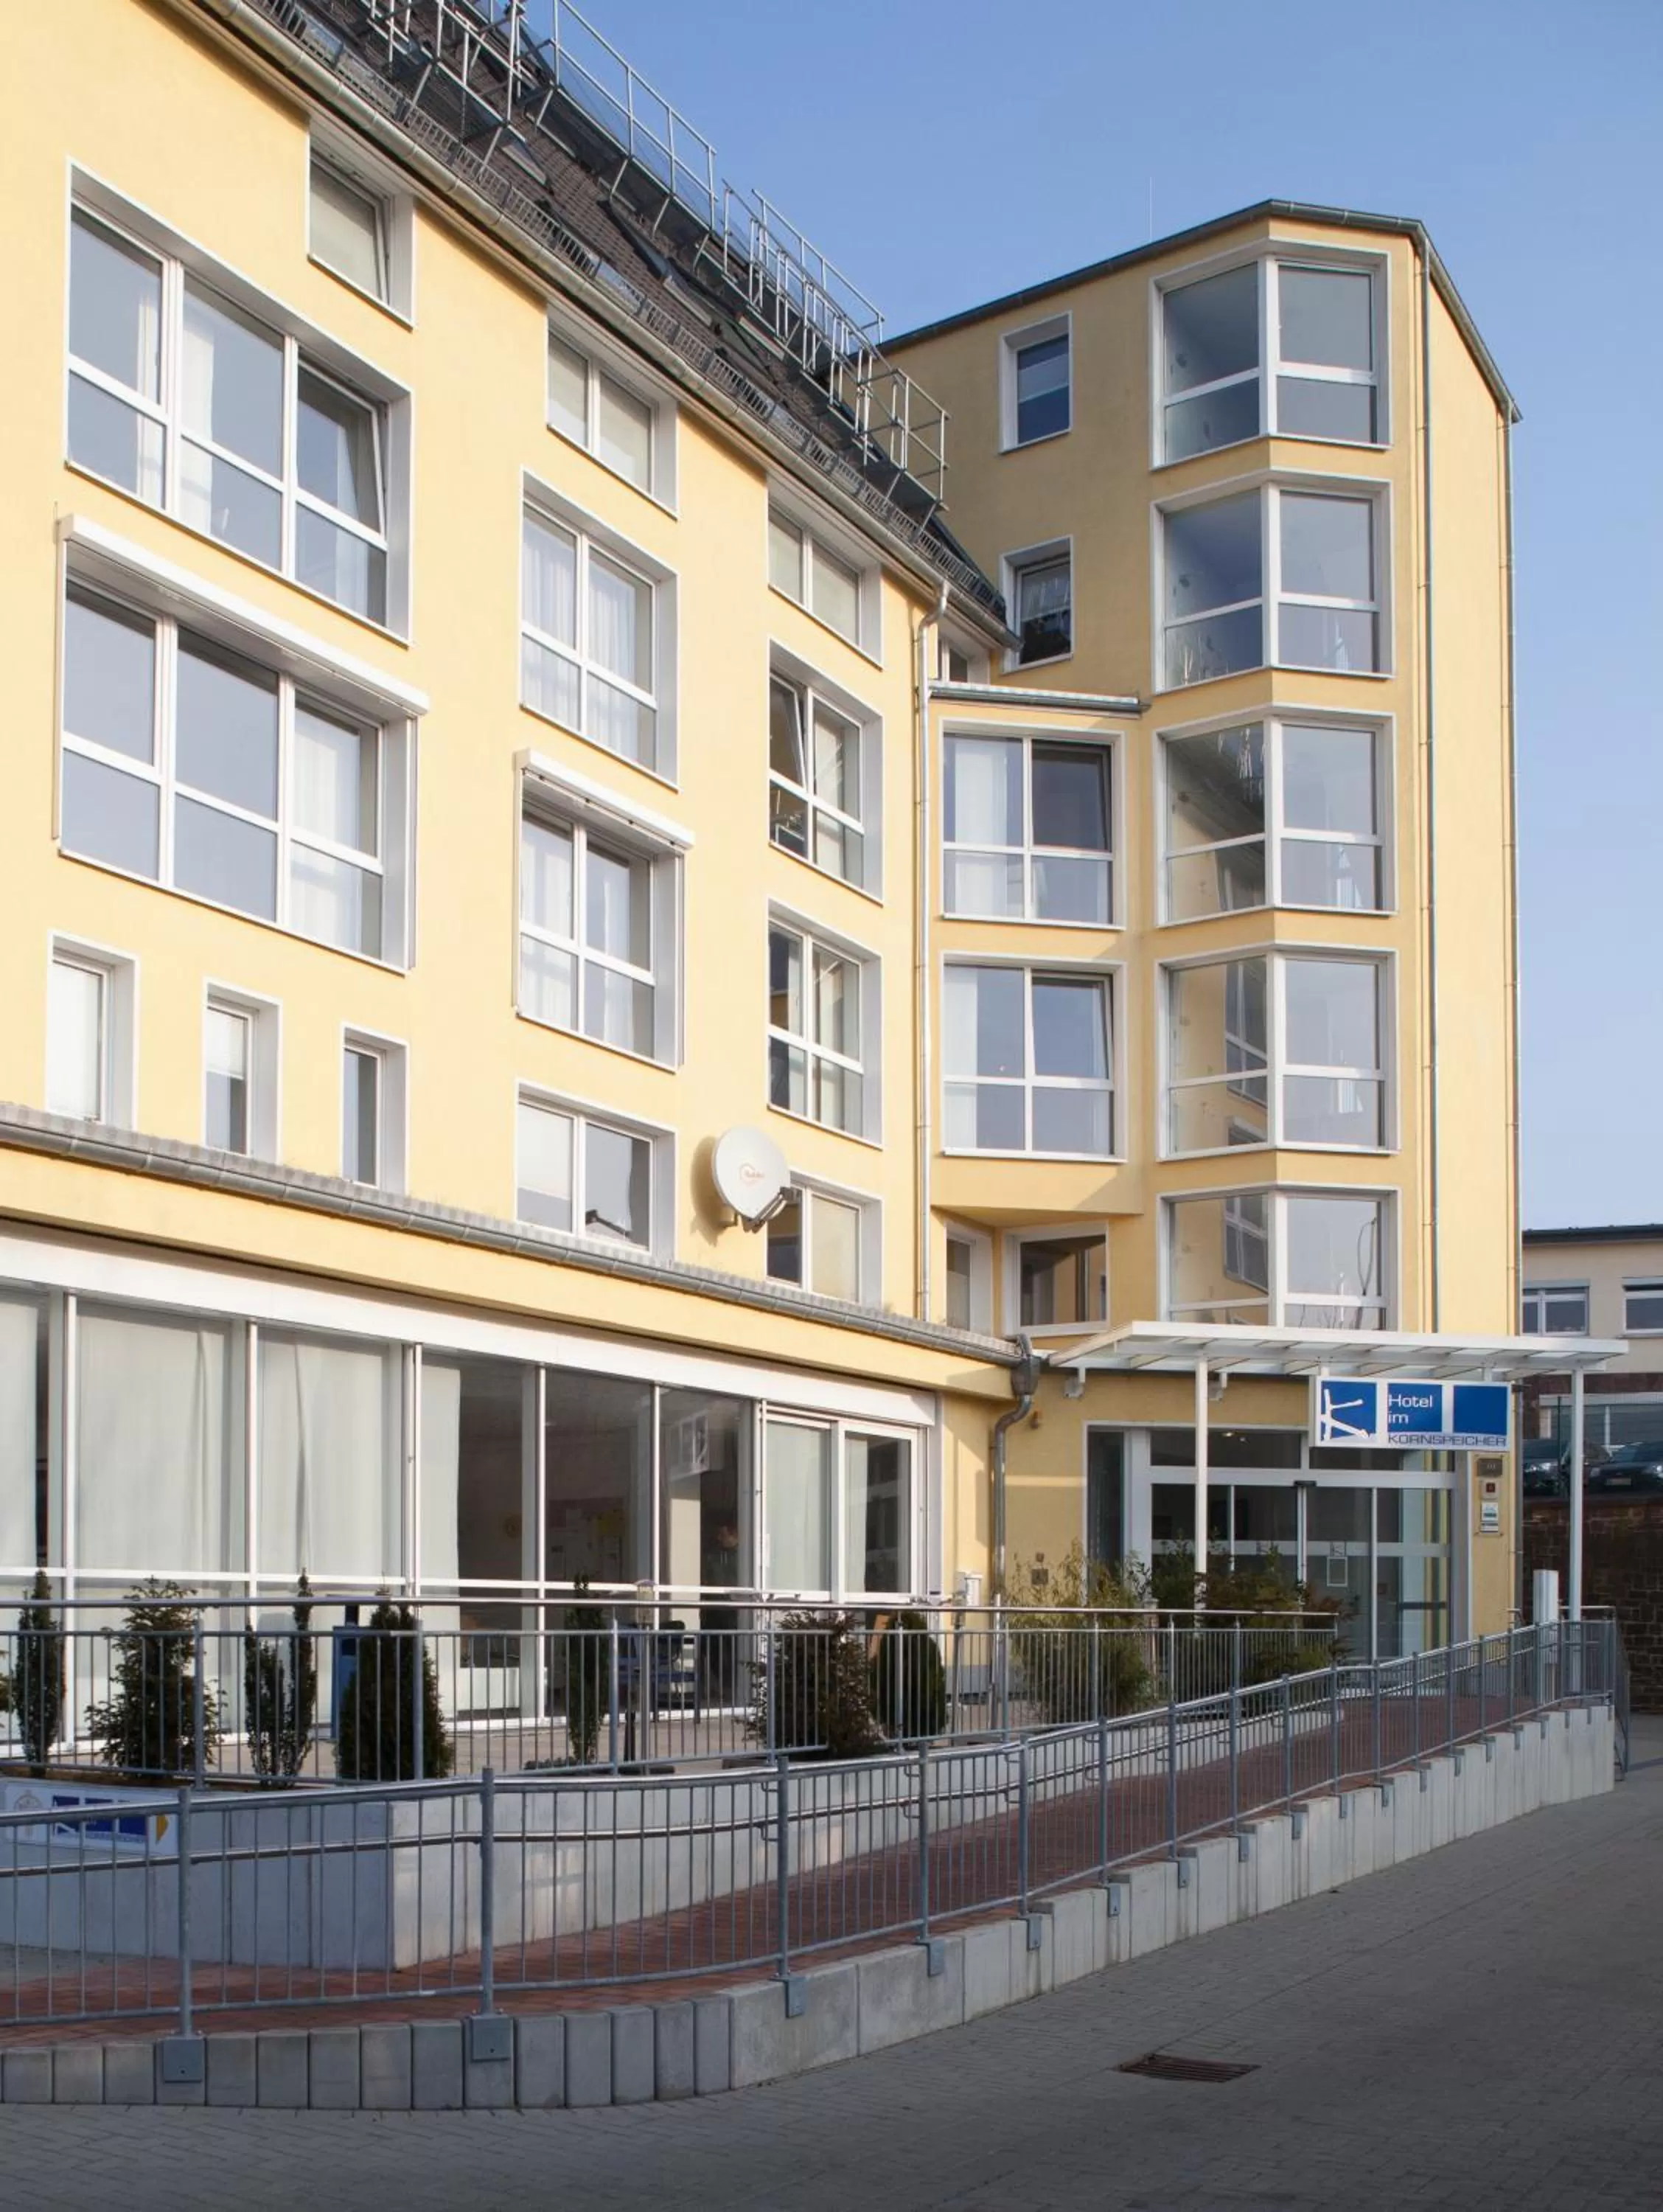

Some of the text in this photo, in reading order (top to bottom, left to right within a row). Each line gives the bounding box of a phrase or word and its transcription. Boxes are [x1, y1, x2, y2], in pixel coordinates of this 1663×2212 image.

[1388, 1394, 1433, 1408] Hotel
[1388, 1411, 1409, 1425] im
[1387, 1434, 1507, 1447] KORNSPEICHER
